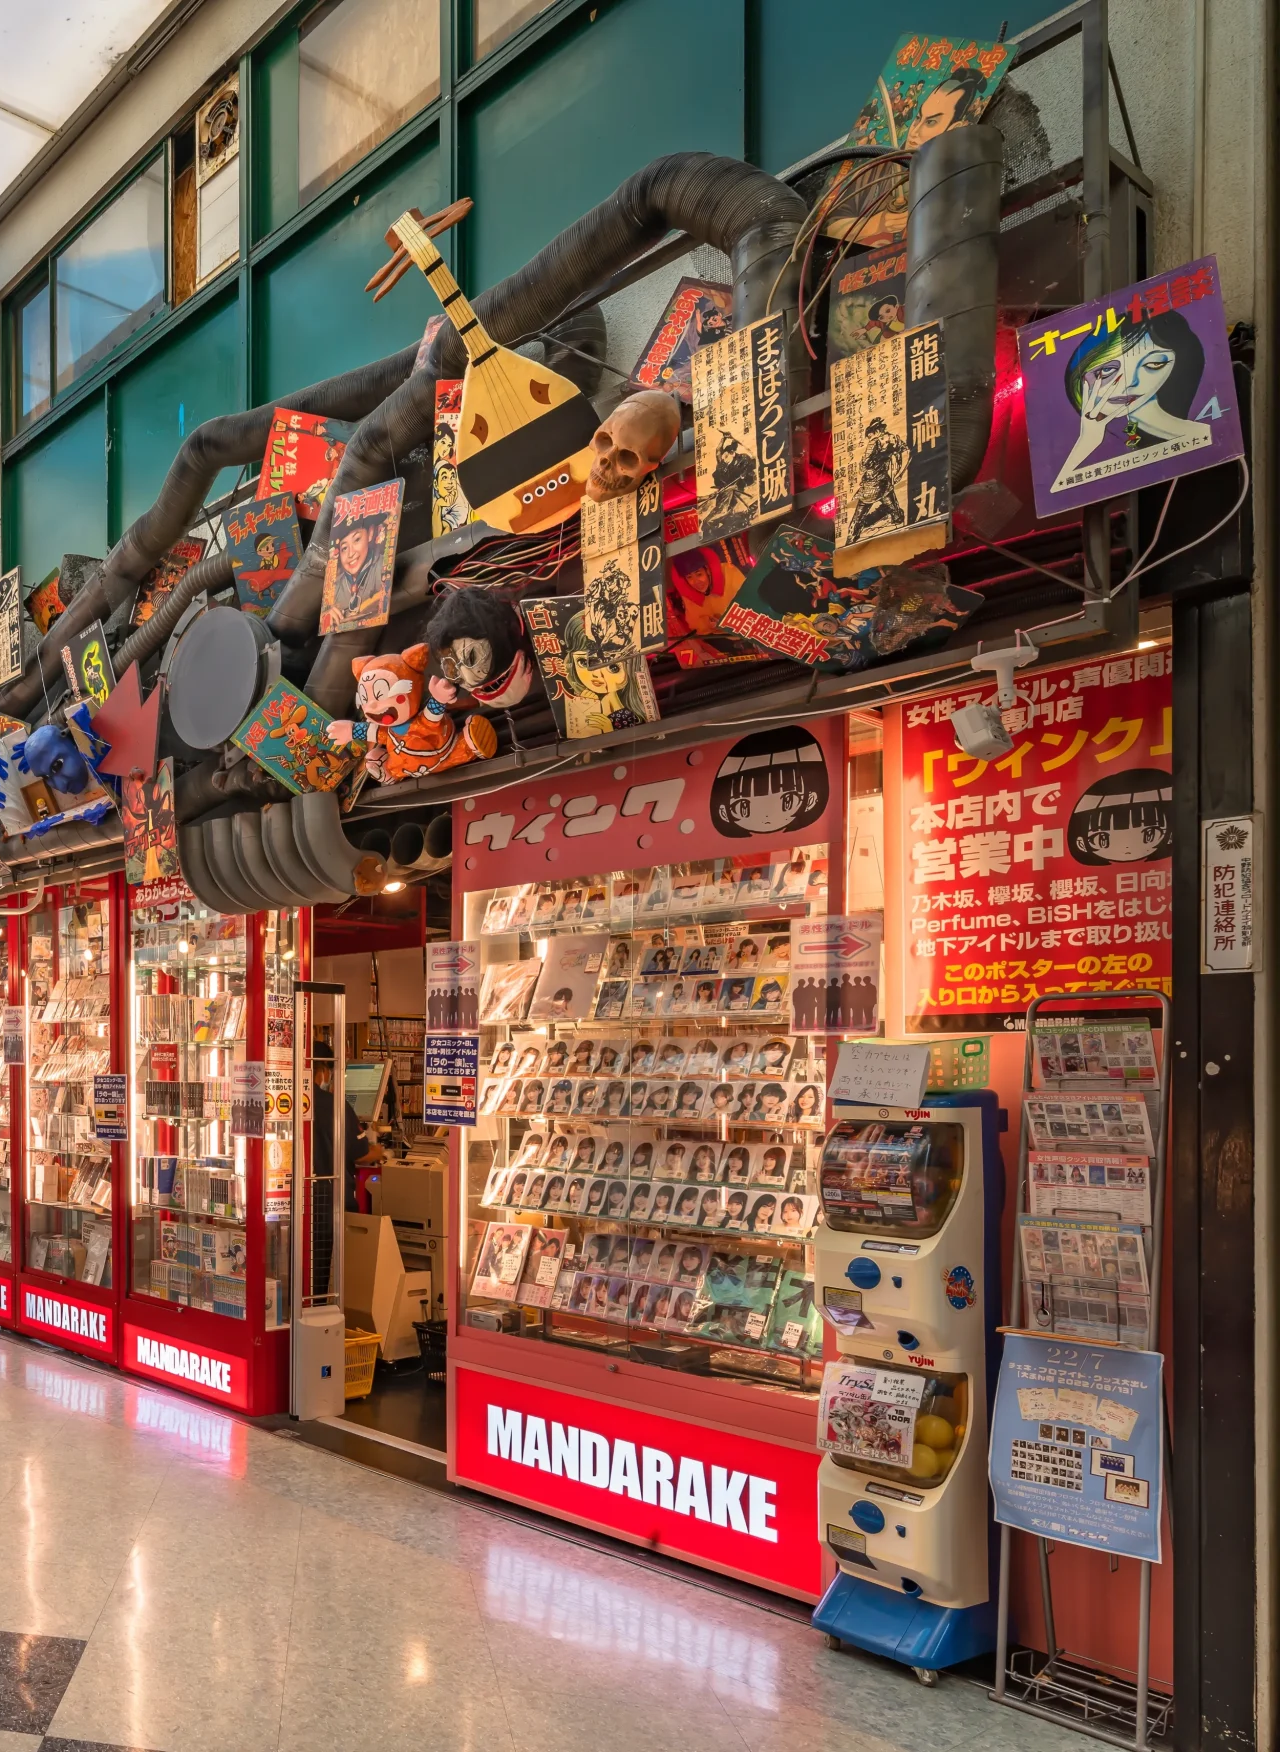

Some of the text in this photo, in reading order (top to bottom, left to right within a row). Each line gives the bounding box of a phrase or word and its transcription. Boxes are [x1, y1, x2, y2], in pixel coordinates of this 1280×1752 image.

[757, 328, 788, 504] まぼろし城
[910, 333, 941, 522] 龍神丸
[271, 436, 285, 496] イヒール
[285, 414, 303, 477] 殺人事件
[228, 496, 293, 546] ラッキーちゃん
[333, 481, 400, 528] 少年画報
[639, 475, 665, 638] 豹の眼
[526, 606, 577, 701] 白痴美人
[907, 651, 1172, 729] 女性アイドル・声優関
[1001, 695, 1083, 732] 専門店
[465, 778, 686, 851] ウィンク
[910, 783, 1062, 833] 本店内で
[912, 825, 1064, 885] 営業中
[912, 869, 1172, 914] 乃木坂、欅坂、櫻坂、日向
[1213, 865, 1236, 951] 防犯連絡所
[431, 946, 475, 957] 男性アイドル
[799, 920, 872, 935] 男性アイドル
[945, 952, 1153, 982] このポスターの左の
[851, 1045, 910, 1062] 空カプセルは
[904, 1110, 930, 1120] YUJIN
[26, 1292, 106, 1343] MANDARAKE
[136, 1336, 231, 1393] MANDARAKE
[908, 1355, 934, 1367] YUJIN
[1046, 1347, 1105, 1371] 22/7
[888, 1414, 911, 1424] 100円
[487, 1404, 778, 1544] MANDARAKE
